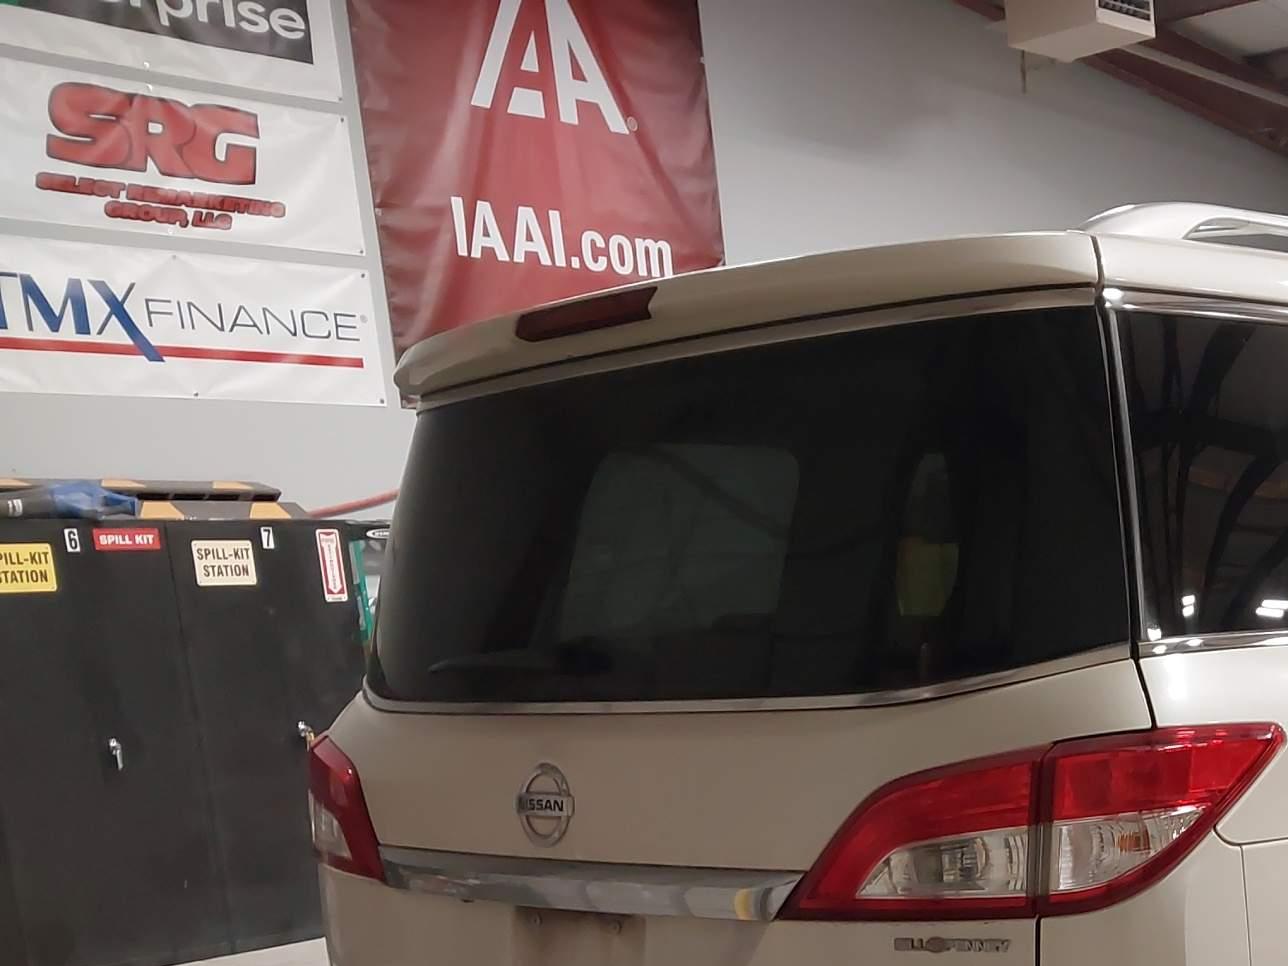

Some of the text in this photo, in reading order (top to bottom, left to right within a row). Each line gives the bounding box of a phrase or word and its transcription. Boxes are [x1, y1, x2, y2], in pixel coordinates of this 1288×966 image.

[46, 82, 260, 185] SRG
[451, 196, 673, 278] IAAI.com
[144, 298, 361, 342] FINANCE
[67, 530, 78, 550] 6
[100, 534, 154, 545] SPILL KIT
[263, 528, 271, 547] 7
[196, 547, 250, 560] SPILL-KIT
[0, 569, 48, 583] TATION
[203, 564, 249, 577] STATION
